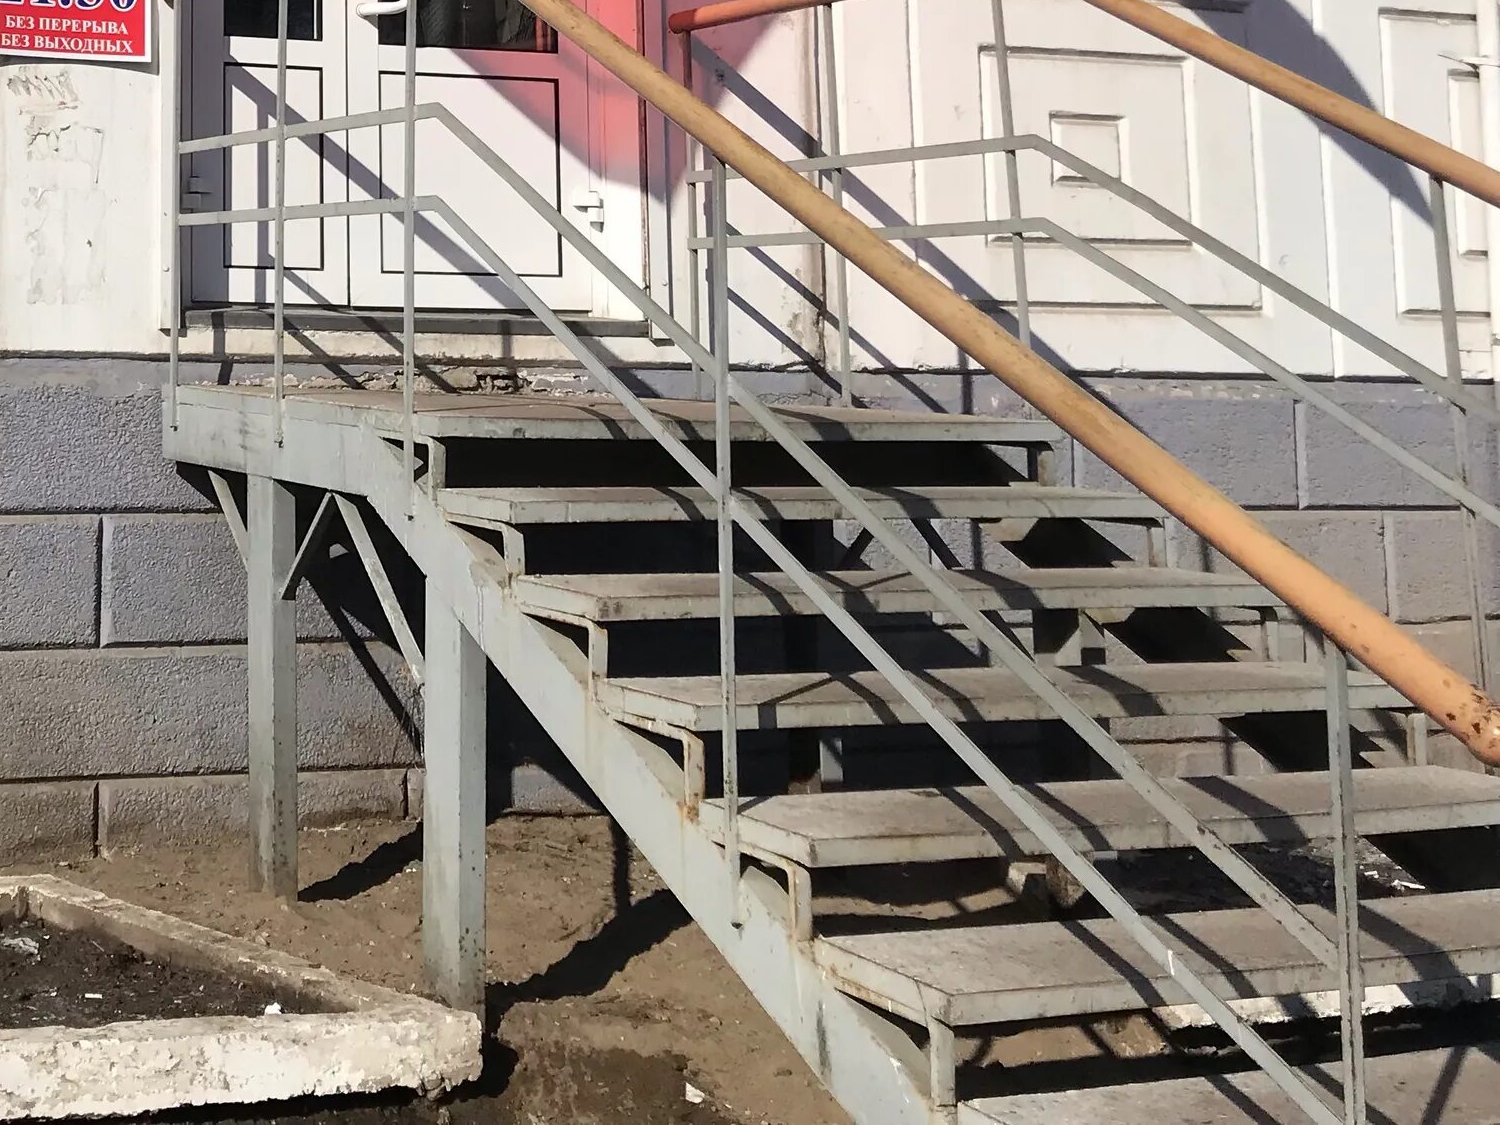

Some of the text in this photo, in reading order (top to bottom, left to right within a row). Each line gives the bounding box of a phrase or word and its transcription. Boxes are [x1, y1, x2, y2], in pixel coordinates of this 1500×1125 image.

[5, 14, 129, 35] БЕЗ ПЕРЕРЫВА
[1, 33, 134, 54] БЕЗ ВЫХОДНЫХ
